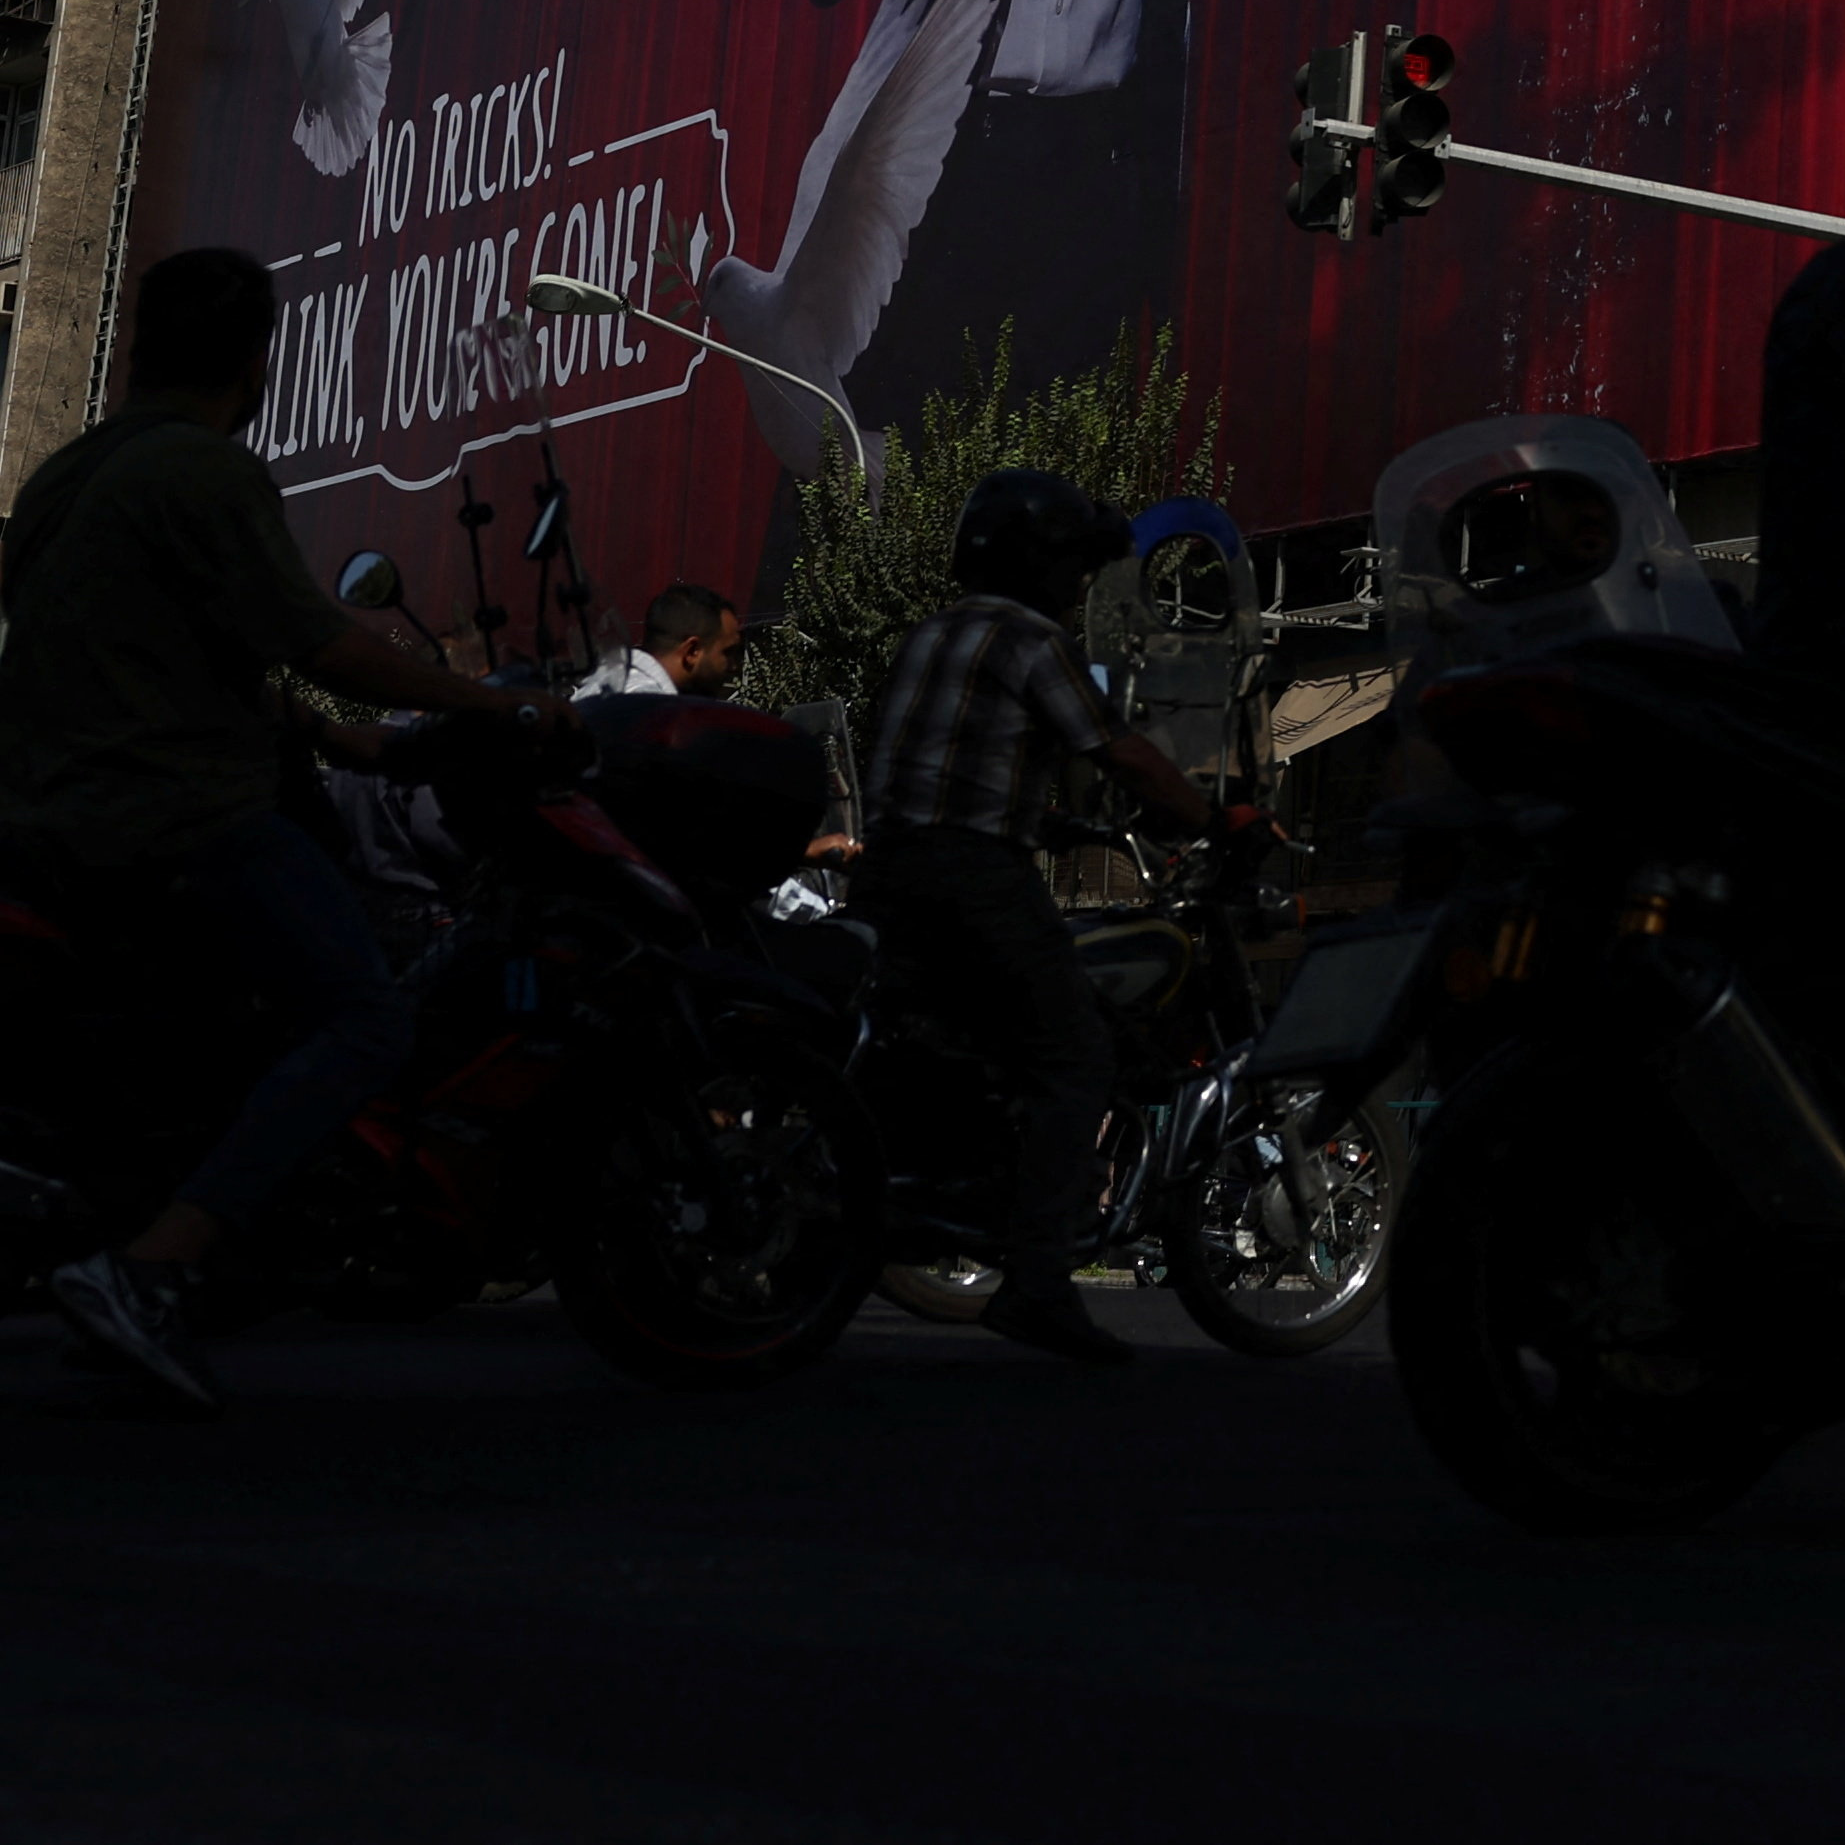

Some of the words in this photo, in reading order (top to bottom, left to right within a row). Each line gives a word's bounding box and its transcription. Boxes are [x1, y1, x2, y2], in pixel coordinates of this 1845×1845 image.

[358, 118, 416, 247] NO
[425, 47, 567, 219] TRICKS!
[525, 177, 663, 388] GONE!
